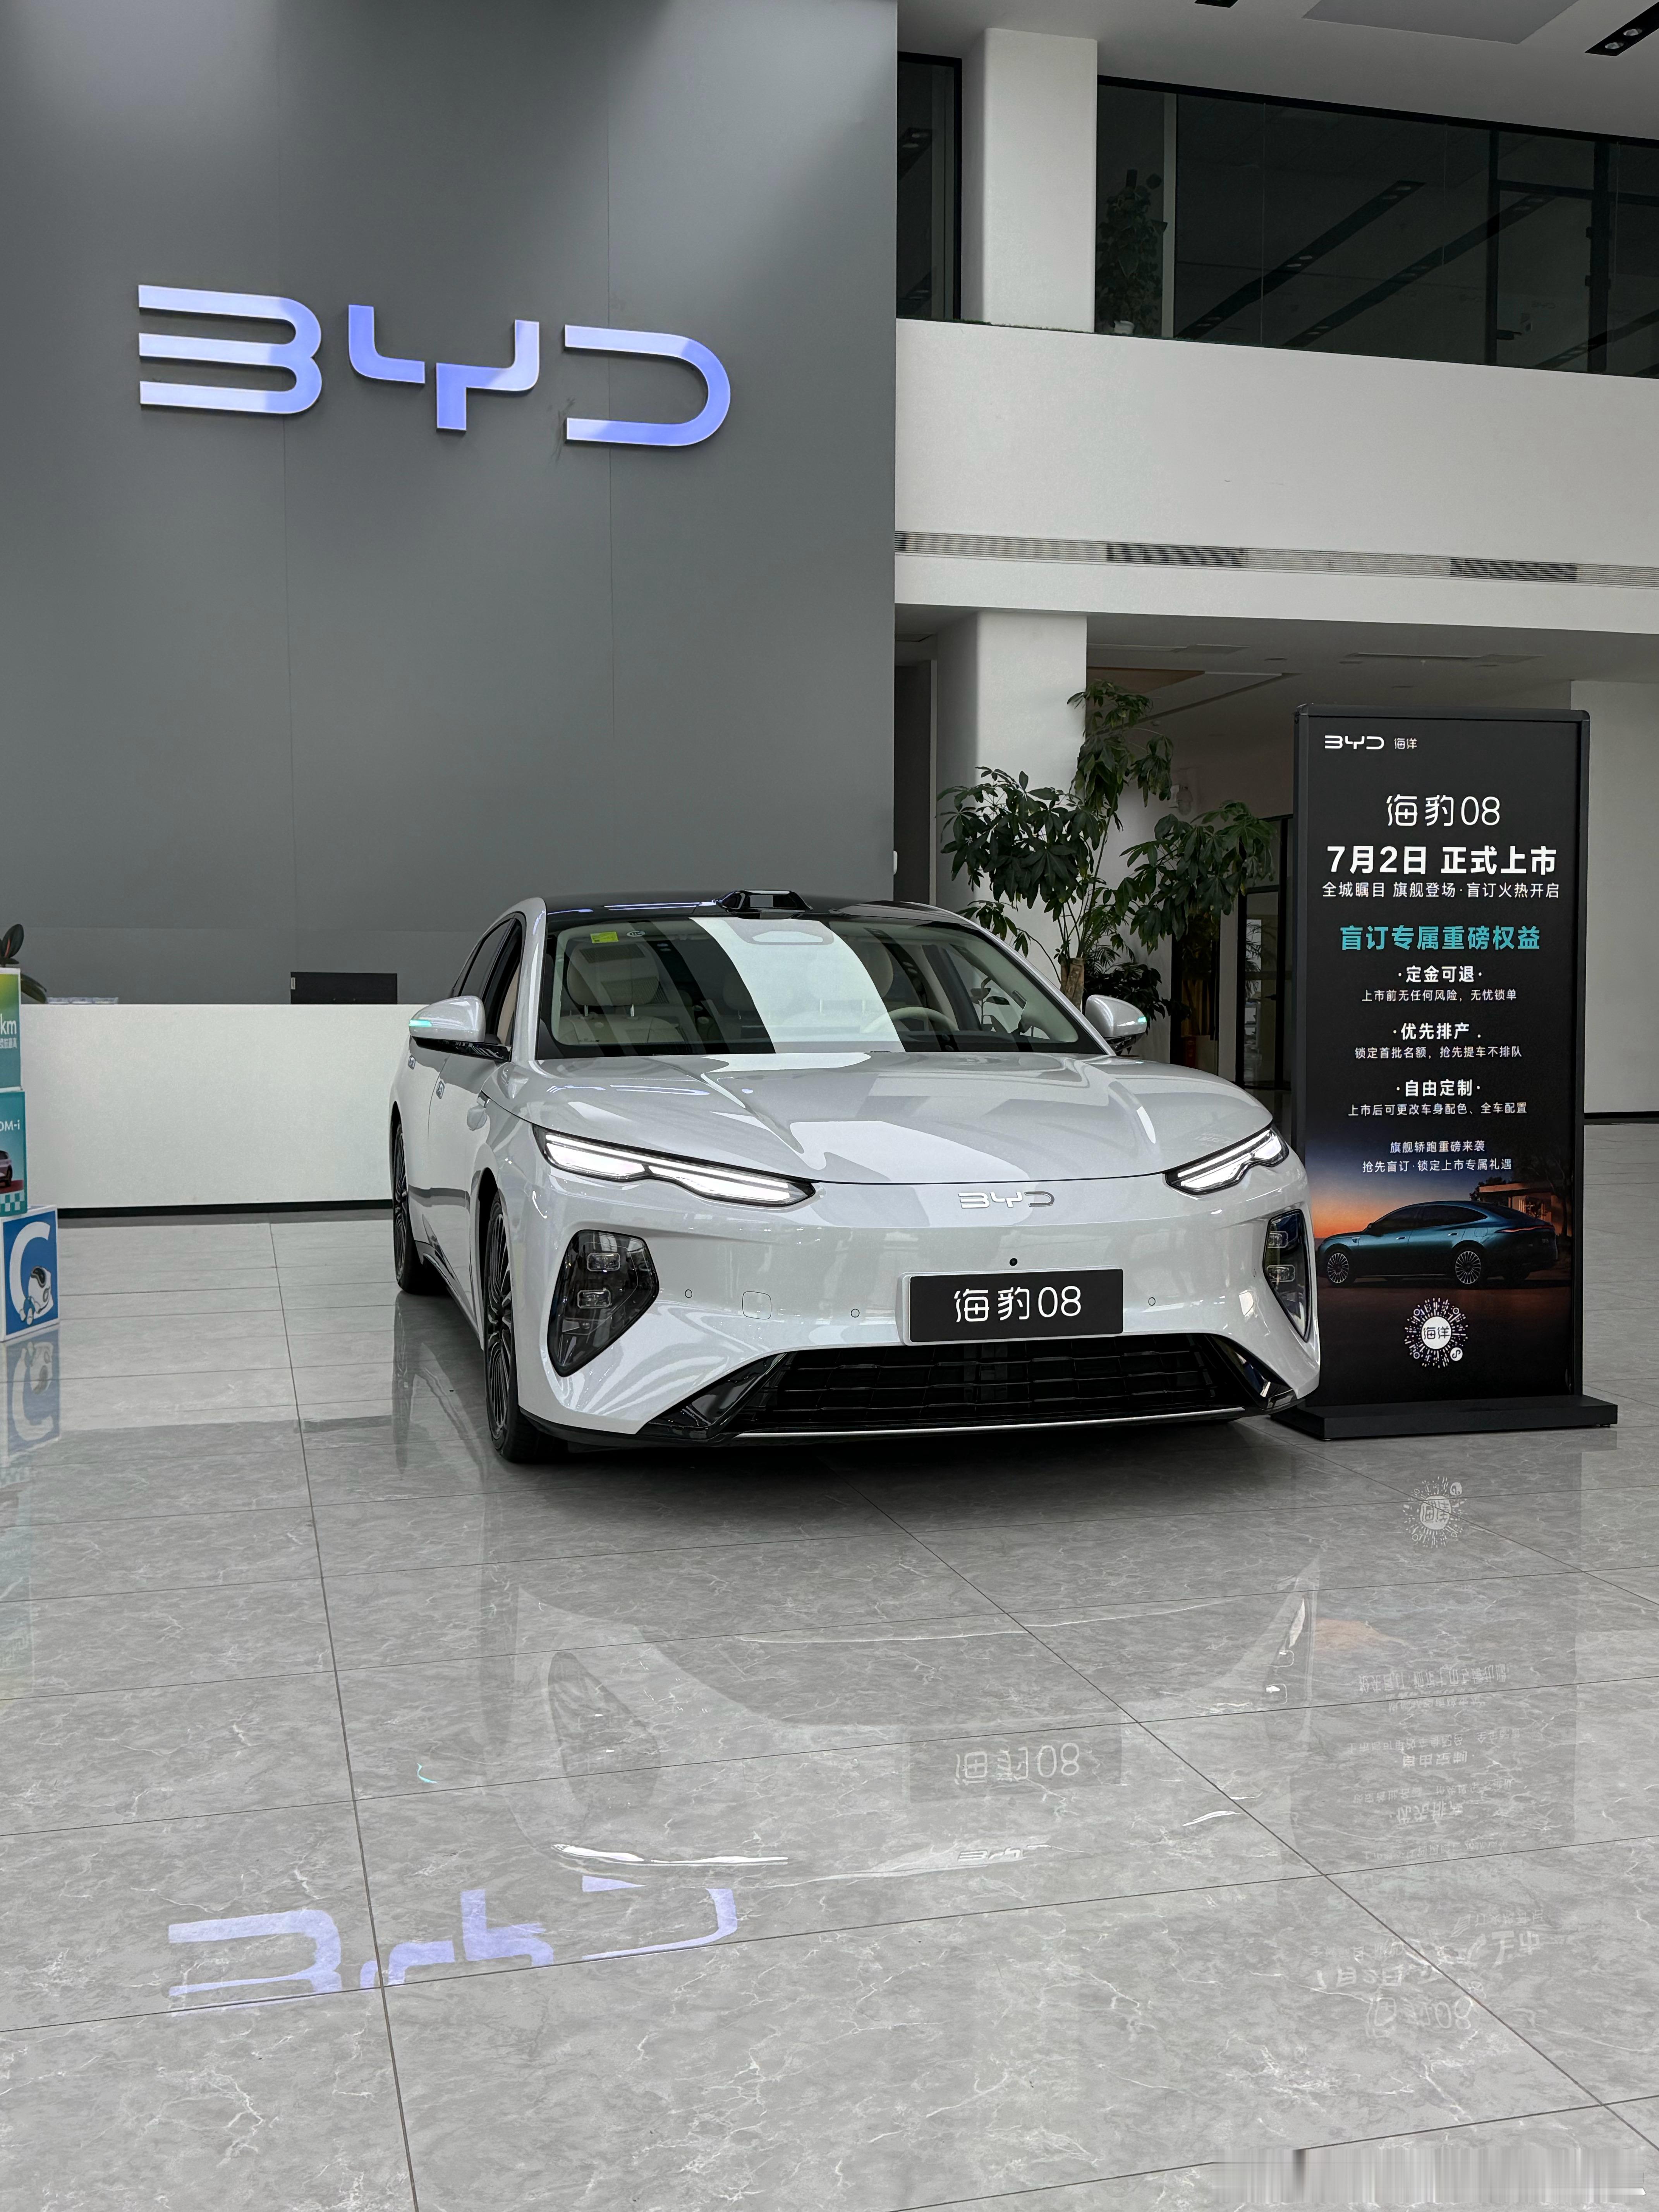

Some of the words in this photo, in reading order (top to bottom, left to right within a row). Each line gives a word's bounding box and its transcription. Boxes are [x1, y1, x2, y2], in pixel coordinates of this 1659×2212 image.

[138, 284, 731, 447] BYD
[1324, 735, 1384, 750] BYD
[1394, 738, 1417, 749] 海洋
[1386, 794, 1500, 826] 海豹08
[1327, 845, 1427, 874] 7月2日
[1441, 845, 1557, 875] 正式上市
[1322, 881, 1385, 898] 全城瞩目
[1340, 925, 1540, 950] 盲订专属重磅权益
[1362, 989, 1517, 1002] 上市前无任何风险，无忧锁单
[1355, 1046, 1522, 1059] 锁定首批名额，抢先提车不排队
[1348, 1102, 1527, 1116] 上市后可更改车身配色、全车配置
[1390, 1140, 1485, 1153] 旗舰轿跑重磅来袭
[1362, 1158, 1512, 1173] 抢先盲订·锁定上市专属礼遇
[958, 1191, 1055, 1209] BYD
[954, 1286, 1081, 1322] 海豹08
[1423, 1326, 1450, 1340] 海洋
